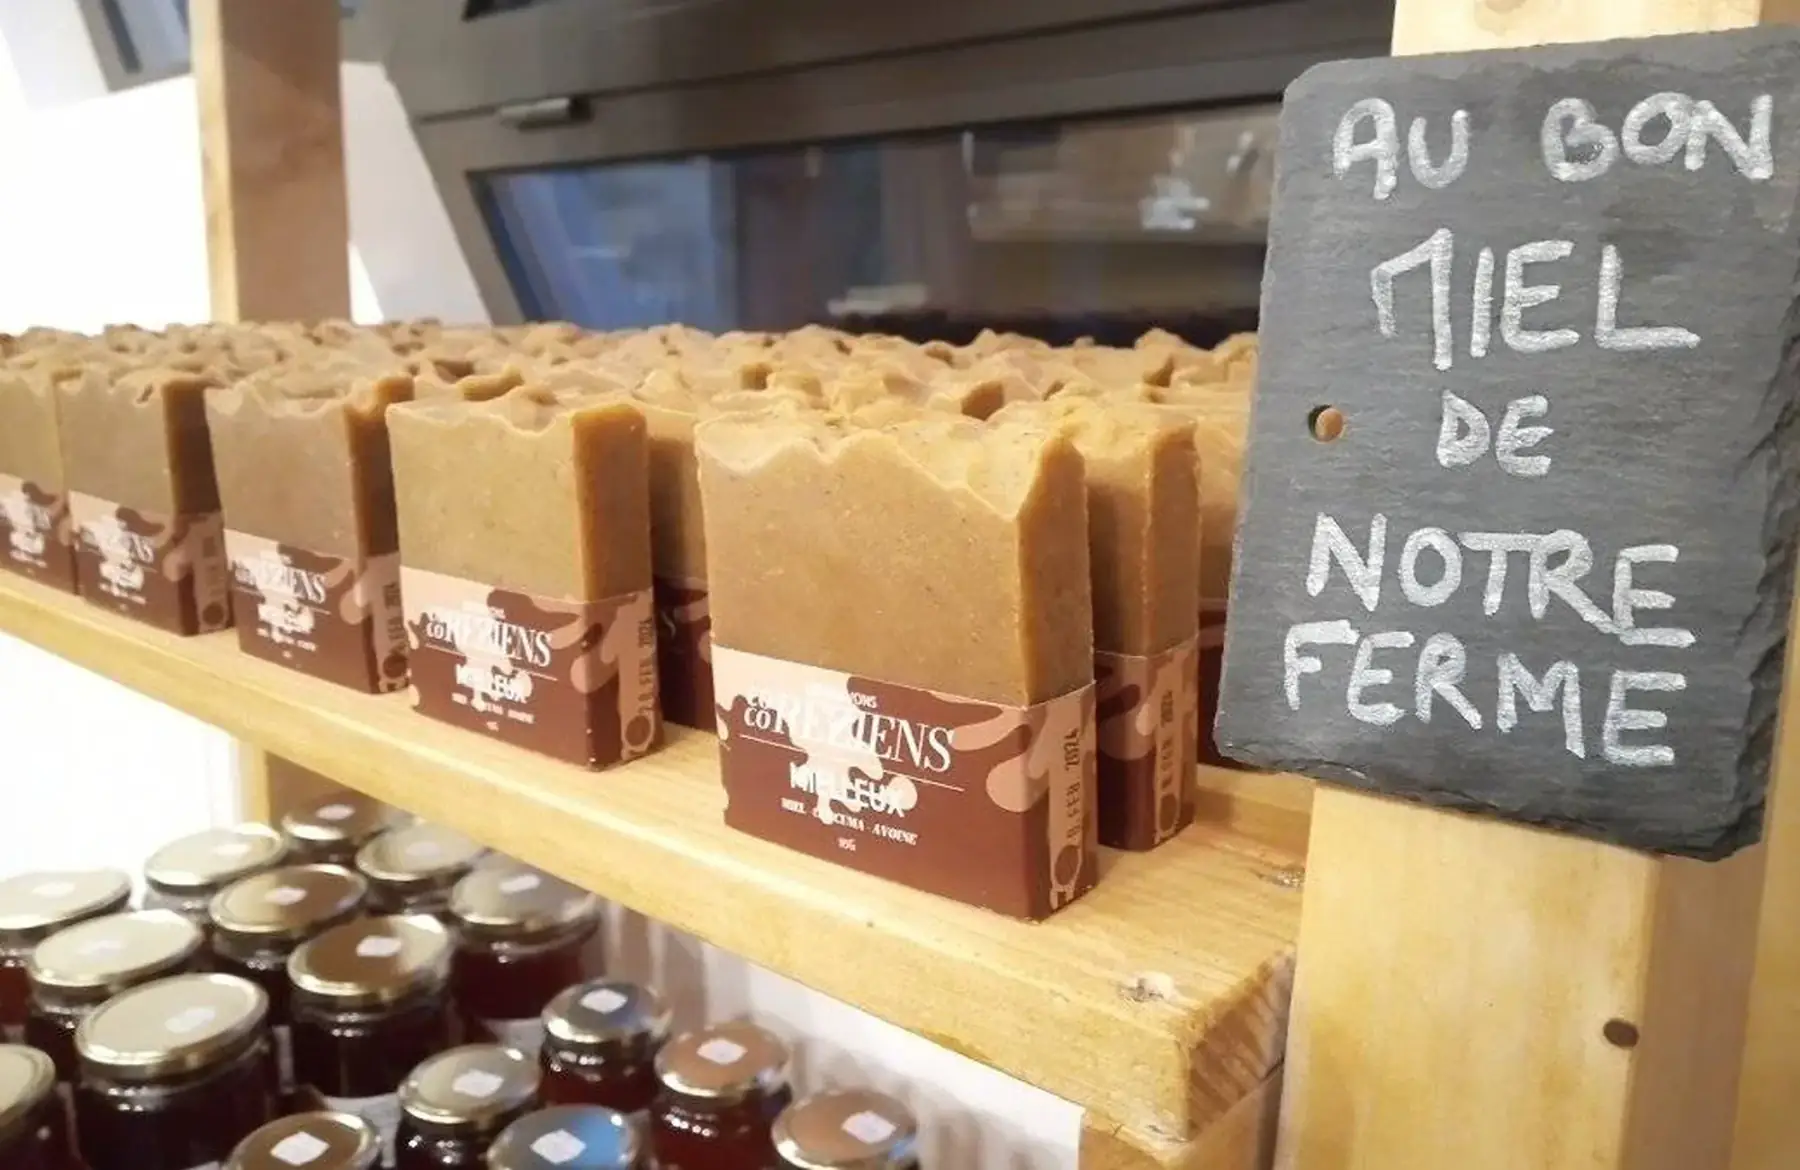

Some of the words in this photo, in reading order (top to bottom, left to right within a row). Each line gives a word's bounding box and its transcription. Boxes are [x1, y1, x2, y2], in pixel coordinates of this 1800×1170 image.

[1331, 97, 1471, 200] AU
[1542, 91, 1774, 182] BON
[1369, 228, 1702, 371] MIEL
[1436, 389, 1555, 477] DE
[1305, 511, 1697, 649] NOTRE
[1283, 619, 1687, 767] FERME
[811, 806, 865, 831] CCUMA
